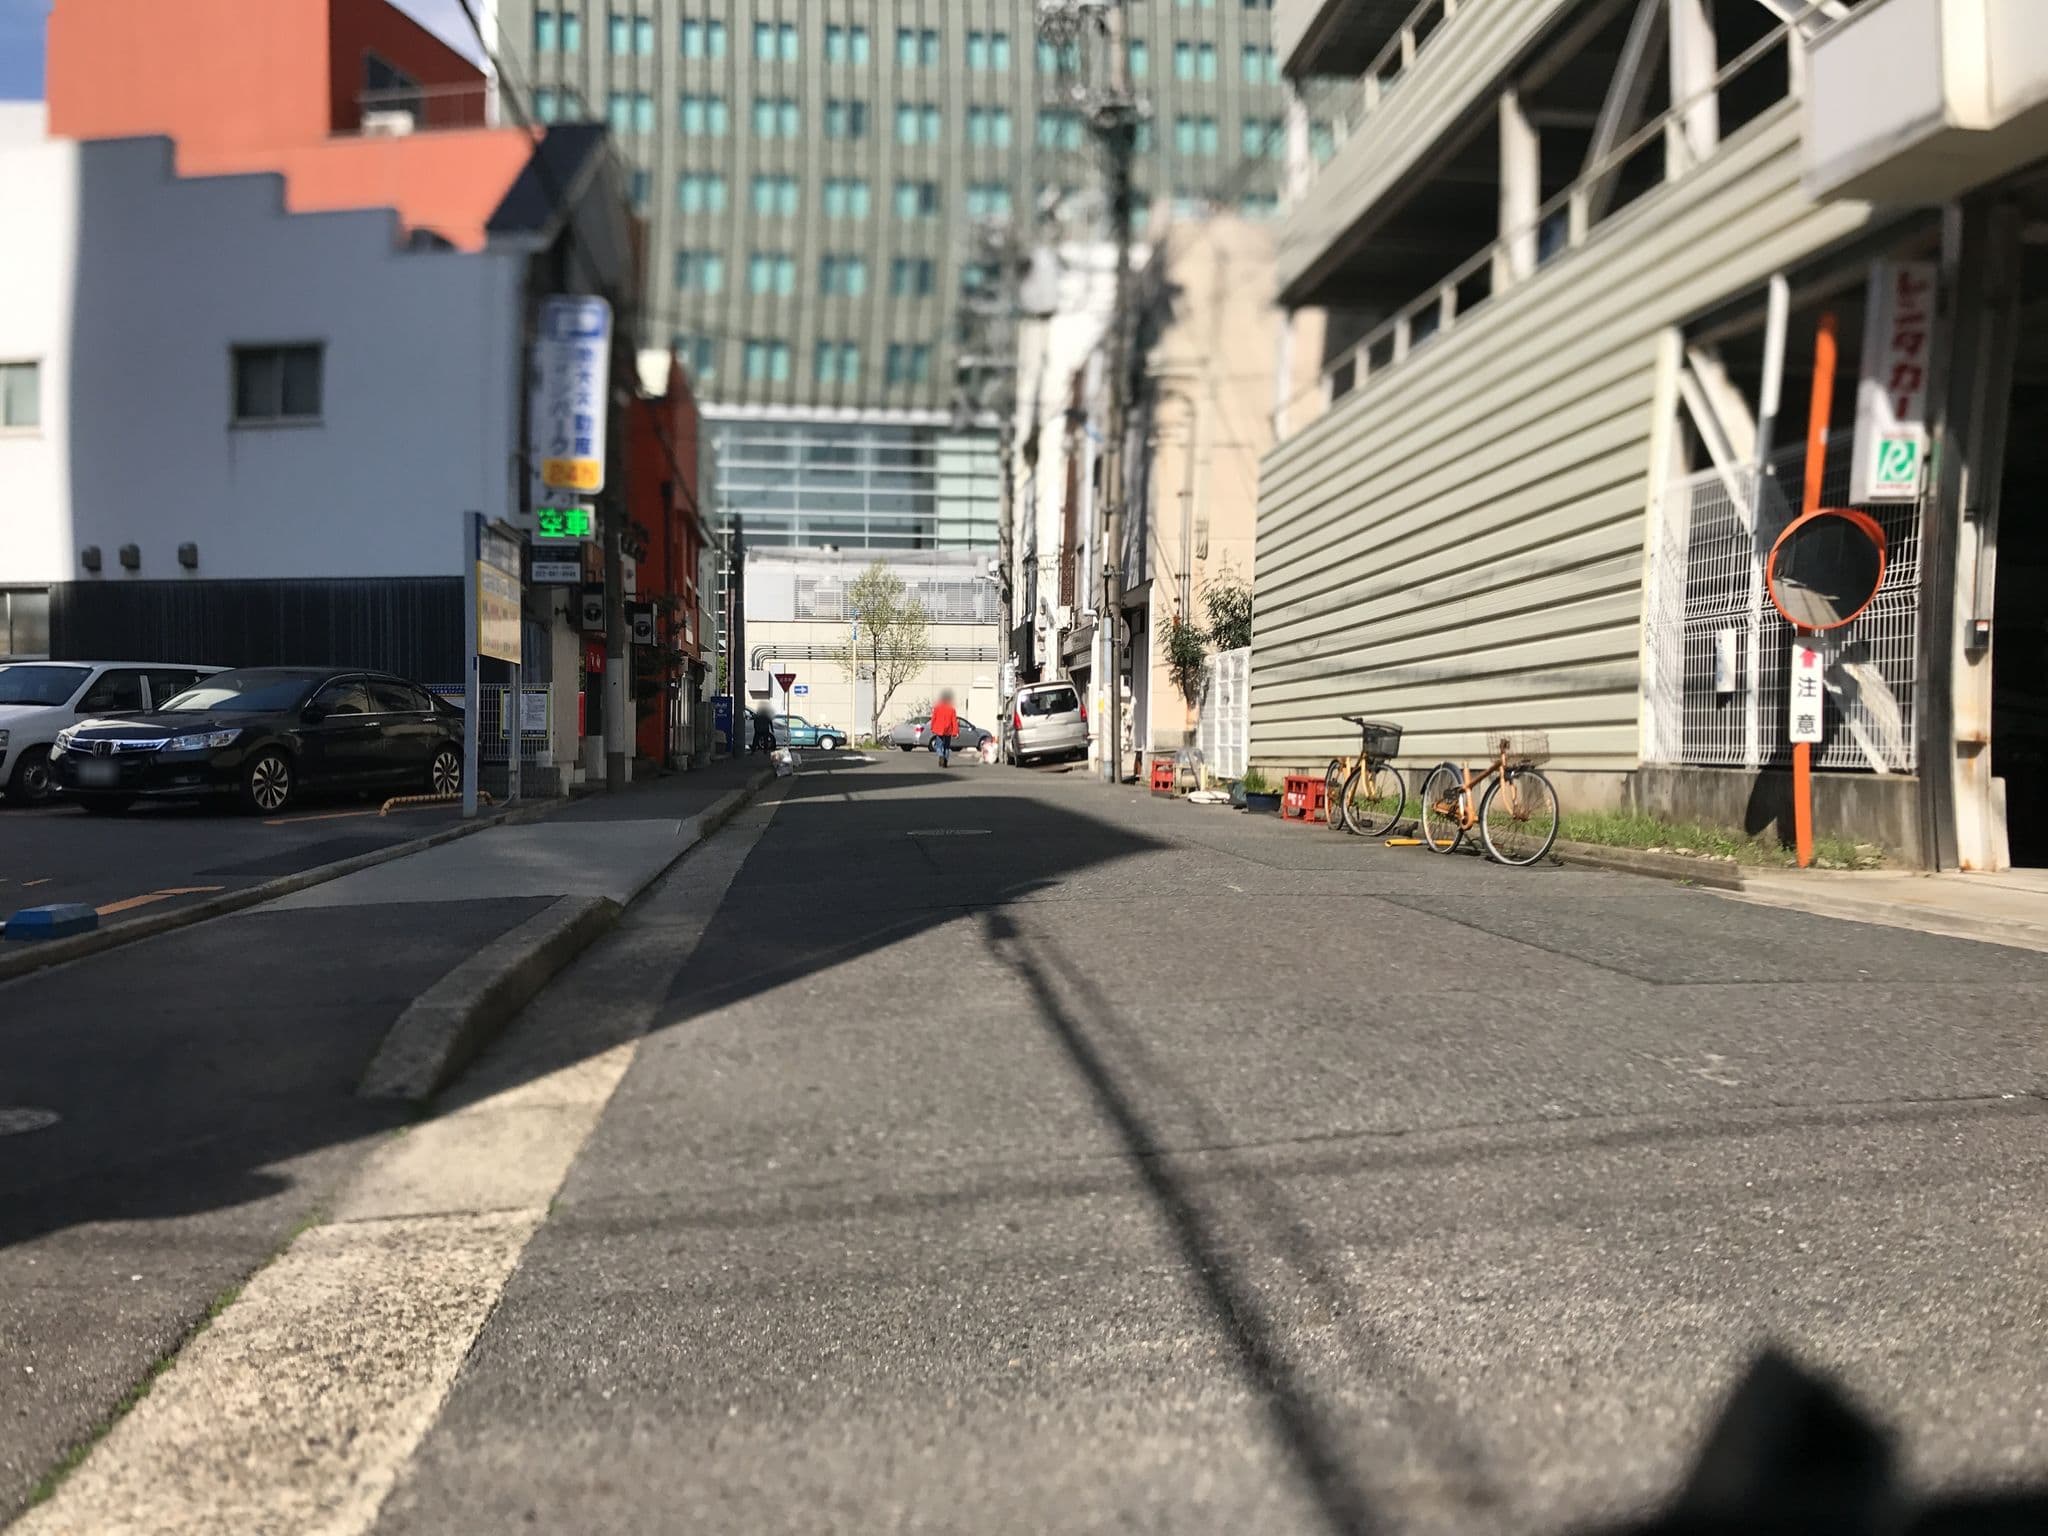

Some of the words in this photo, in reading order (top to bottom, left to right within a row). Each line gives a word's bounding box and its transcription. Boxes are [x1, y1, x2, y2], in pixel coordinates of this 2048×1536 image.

[1888, 271, 1929, 421] レンタカー
[537, 508, 592, 538] 空車
[1797, 676, 1817, 734] 注意
